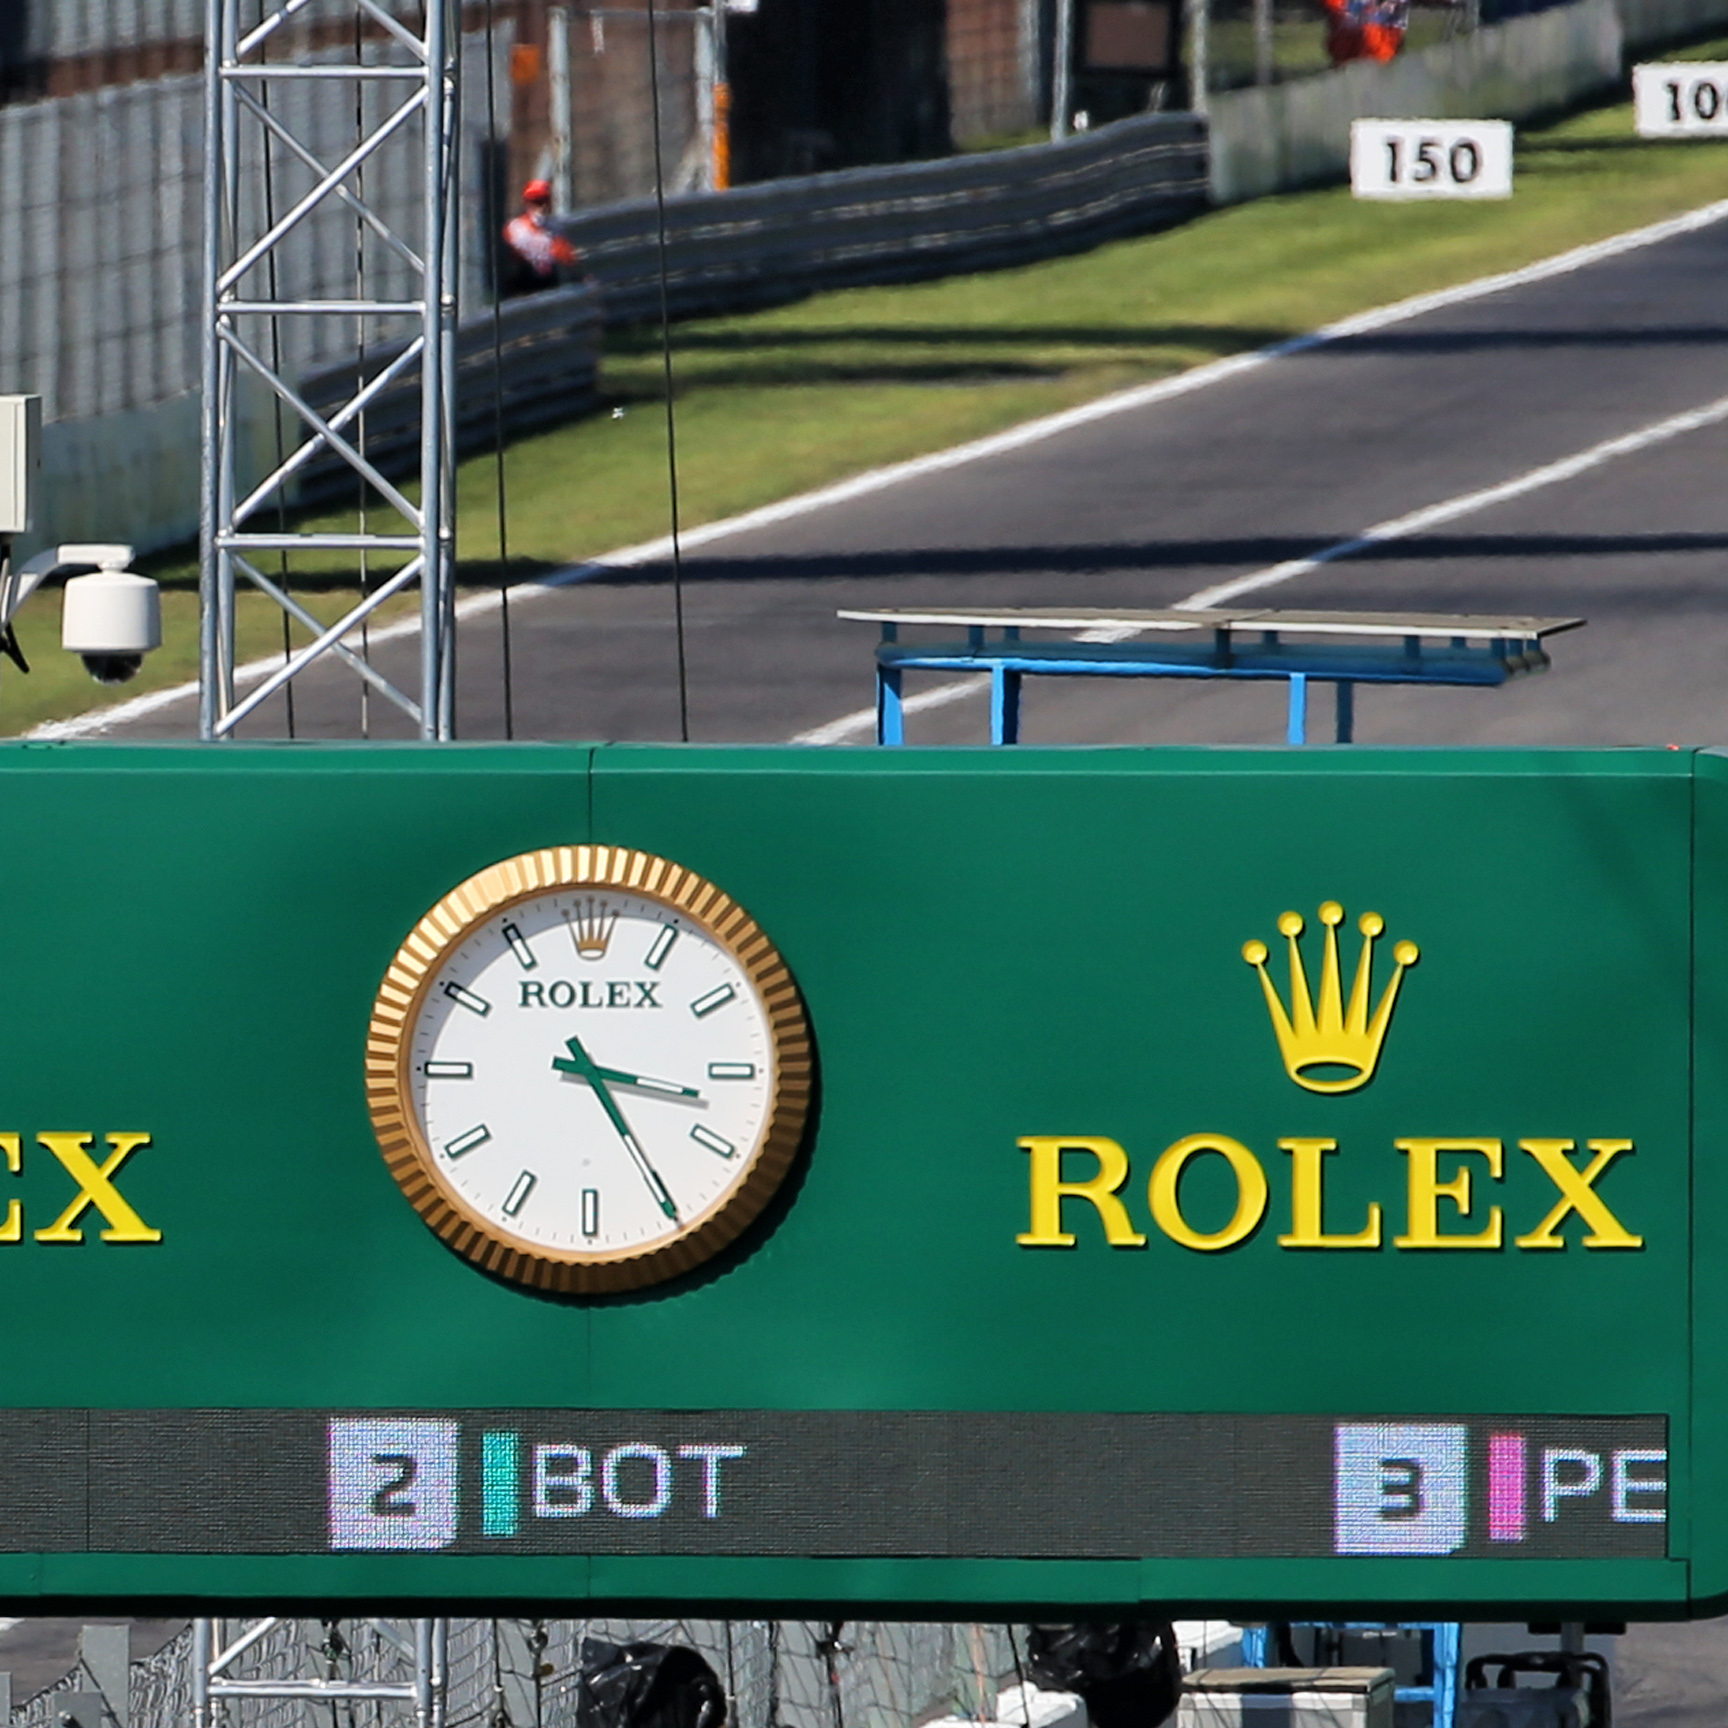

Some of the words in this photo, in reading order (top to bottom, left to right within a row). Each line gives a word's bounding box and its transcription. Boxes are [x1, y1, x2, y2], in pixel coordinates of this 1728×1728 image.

[1386, 136, 1484, 183] 150
[518, 981, 663, 1009] ROLEX
[1015, 1132, 1643, 1250] ROLEX
[372, 1455, 419, 1516] 2
[531, 1444, 746, 1520] BOT
[1377, 1460, 1421, 1518] 3
[1542, 1449, 1667, 1521] PE
